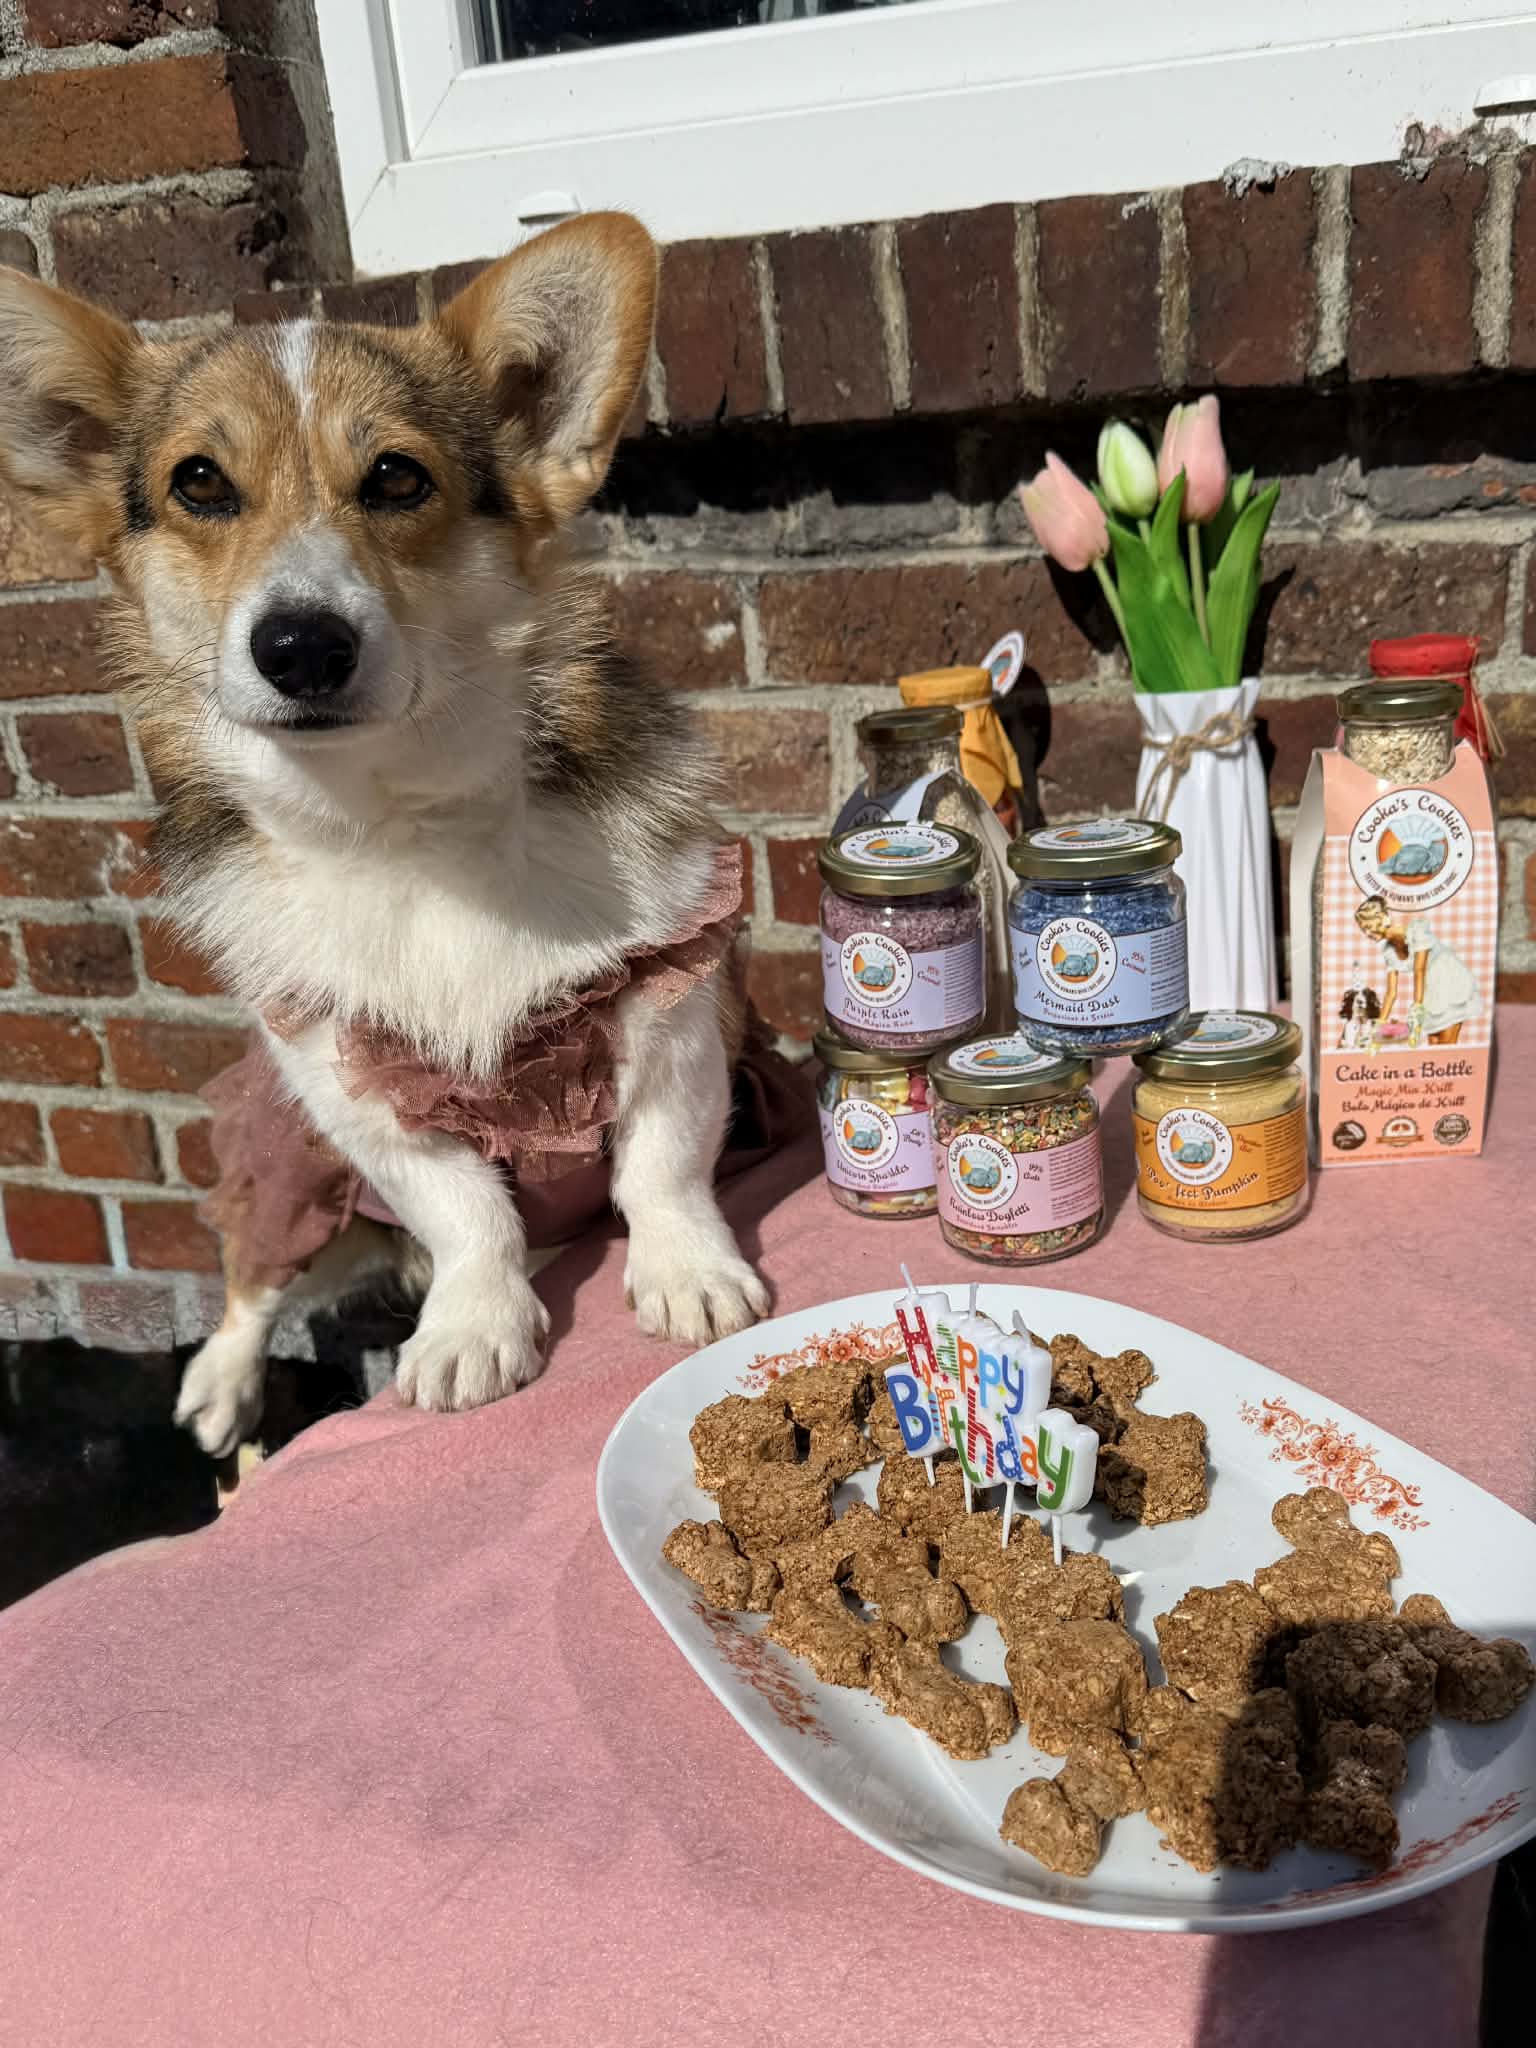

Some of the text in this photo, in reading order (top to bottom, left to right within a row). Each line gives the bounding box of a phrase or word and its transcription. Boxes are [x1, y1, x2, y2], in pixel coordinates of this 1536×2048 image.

[1358, 794, 1465, 844] Cooka's Cookies
[843, 935, 870, 960] Cooka's
[874, 935, 907, 968] Cookies
[1040, 920, 1111, 954] Cooka's Cookies
[844, 997, 911, 1020] Purple Rain
[1033, 990, 1121, 1014] Mermaid Dust
[1335, 1059, 1474, 1082] Cake in a Bottle
[1355, 1081, 1454, 1099] Magic Mix Krill
[1417, 1097, 1432, 1109] de
[1433, 1095, 1467, 1108] Krill
[860, 1102, 891, 1132] Cookies
[1159, 1112, 1188, 1139] Cooka's
[1192, 1111, 1227, 1143] Cookies
[950, 1137, 974, 1163] Cooka's
[978, 1137, 1013, 1169] Cookies
[836, 1158, 867, 1181] Unicorn
[868, 1163, 910, 1184] Sparkles
[1202, 1170, 1260, 1201] Pumpkin
[950, 1196, 1031, 1222] Rainbow Dogfetti
[896, 1305, 1024, 1415] Happy
[886, 1369, 1075, 1510] Birthday
